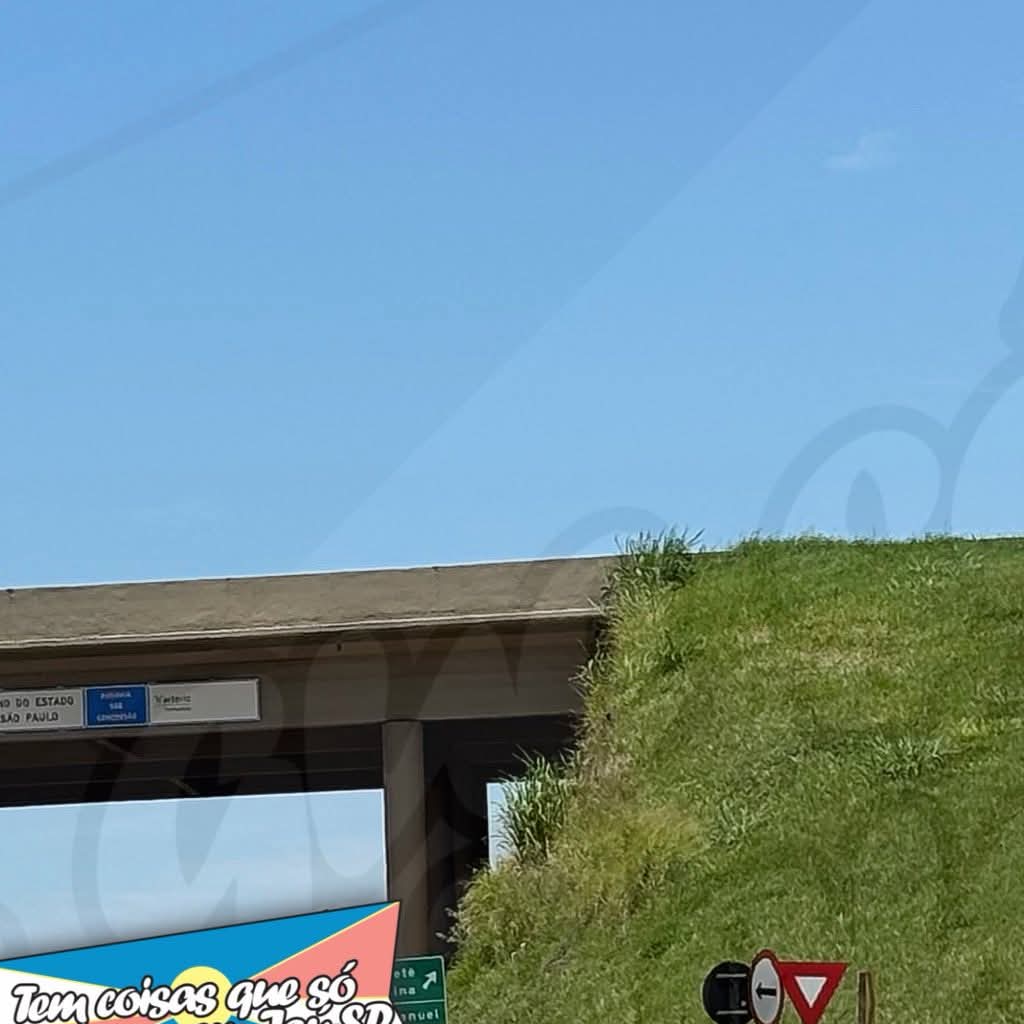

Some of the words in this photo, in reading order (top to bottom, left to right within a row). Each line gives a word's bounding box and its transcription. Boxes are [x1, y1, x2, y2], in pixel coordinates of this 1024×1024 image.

[15, 698, 30, 708] DO
[35, 695, 75, 708] ESTADO
[0, 711, 21, 724] SÃO
[25, 711, 60, 723] PAULO
